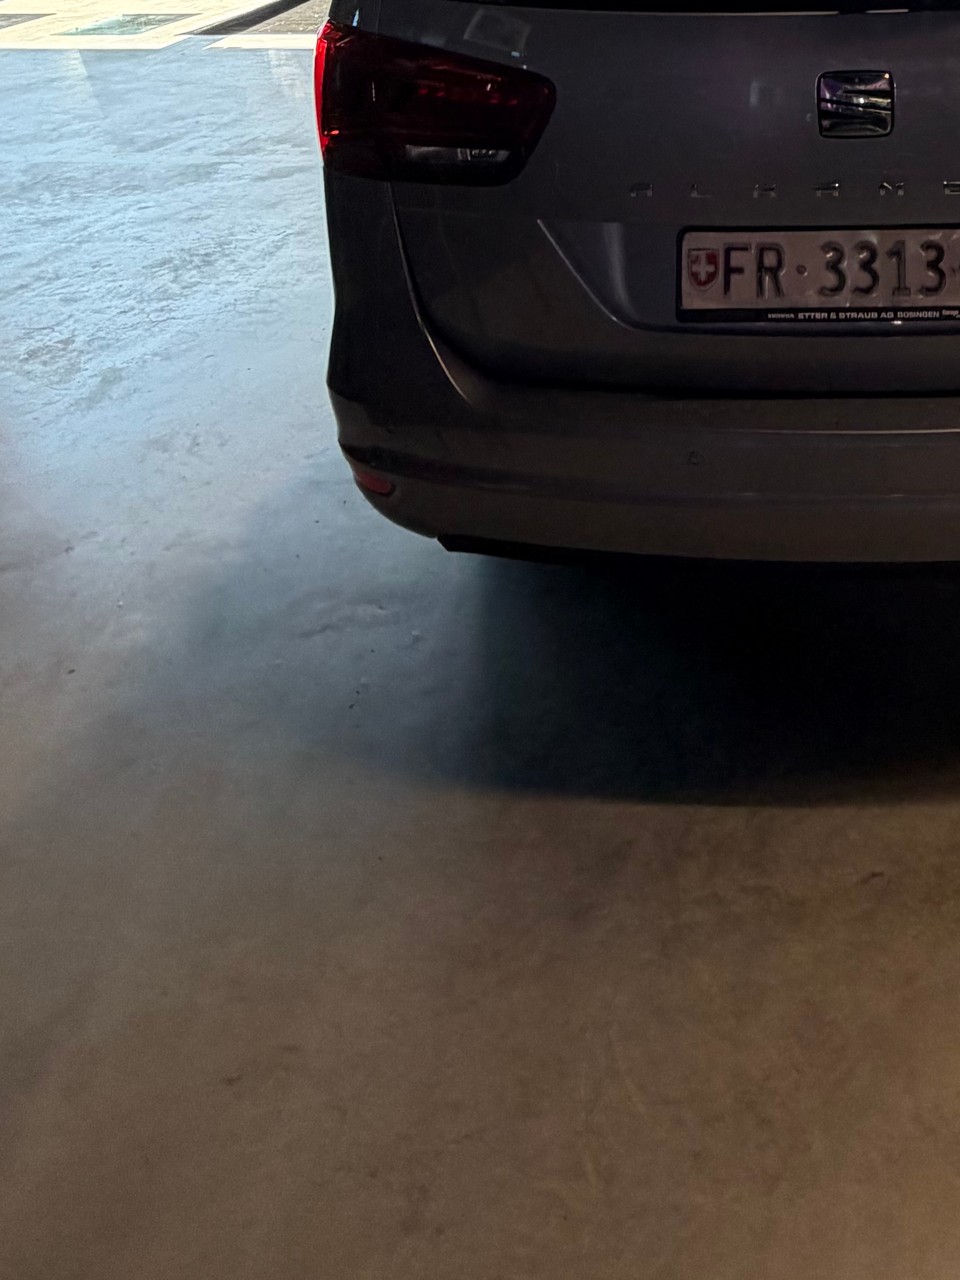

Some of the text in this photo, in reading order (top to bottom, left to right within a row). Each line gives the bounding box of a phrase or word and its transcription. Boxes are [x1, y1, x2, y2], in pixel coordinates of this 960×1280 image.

[722, 241, 787, 299] FR
[816, 239, 948, 298] 3313
[798, 311, 828, 319] ETTER
[838, 310, 878, 319] STRAUB
[880, 310, 894, 319] AG
